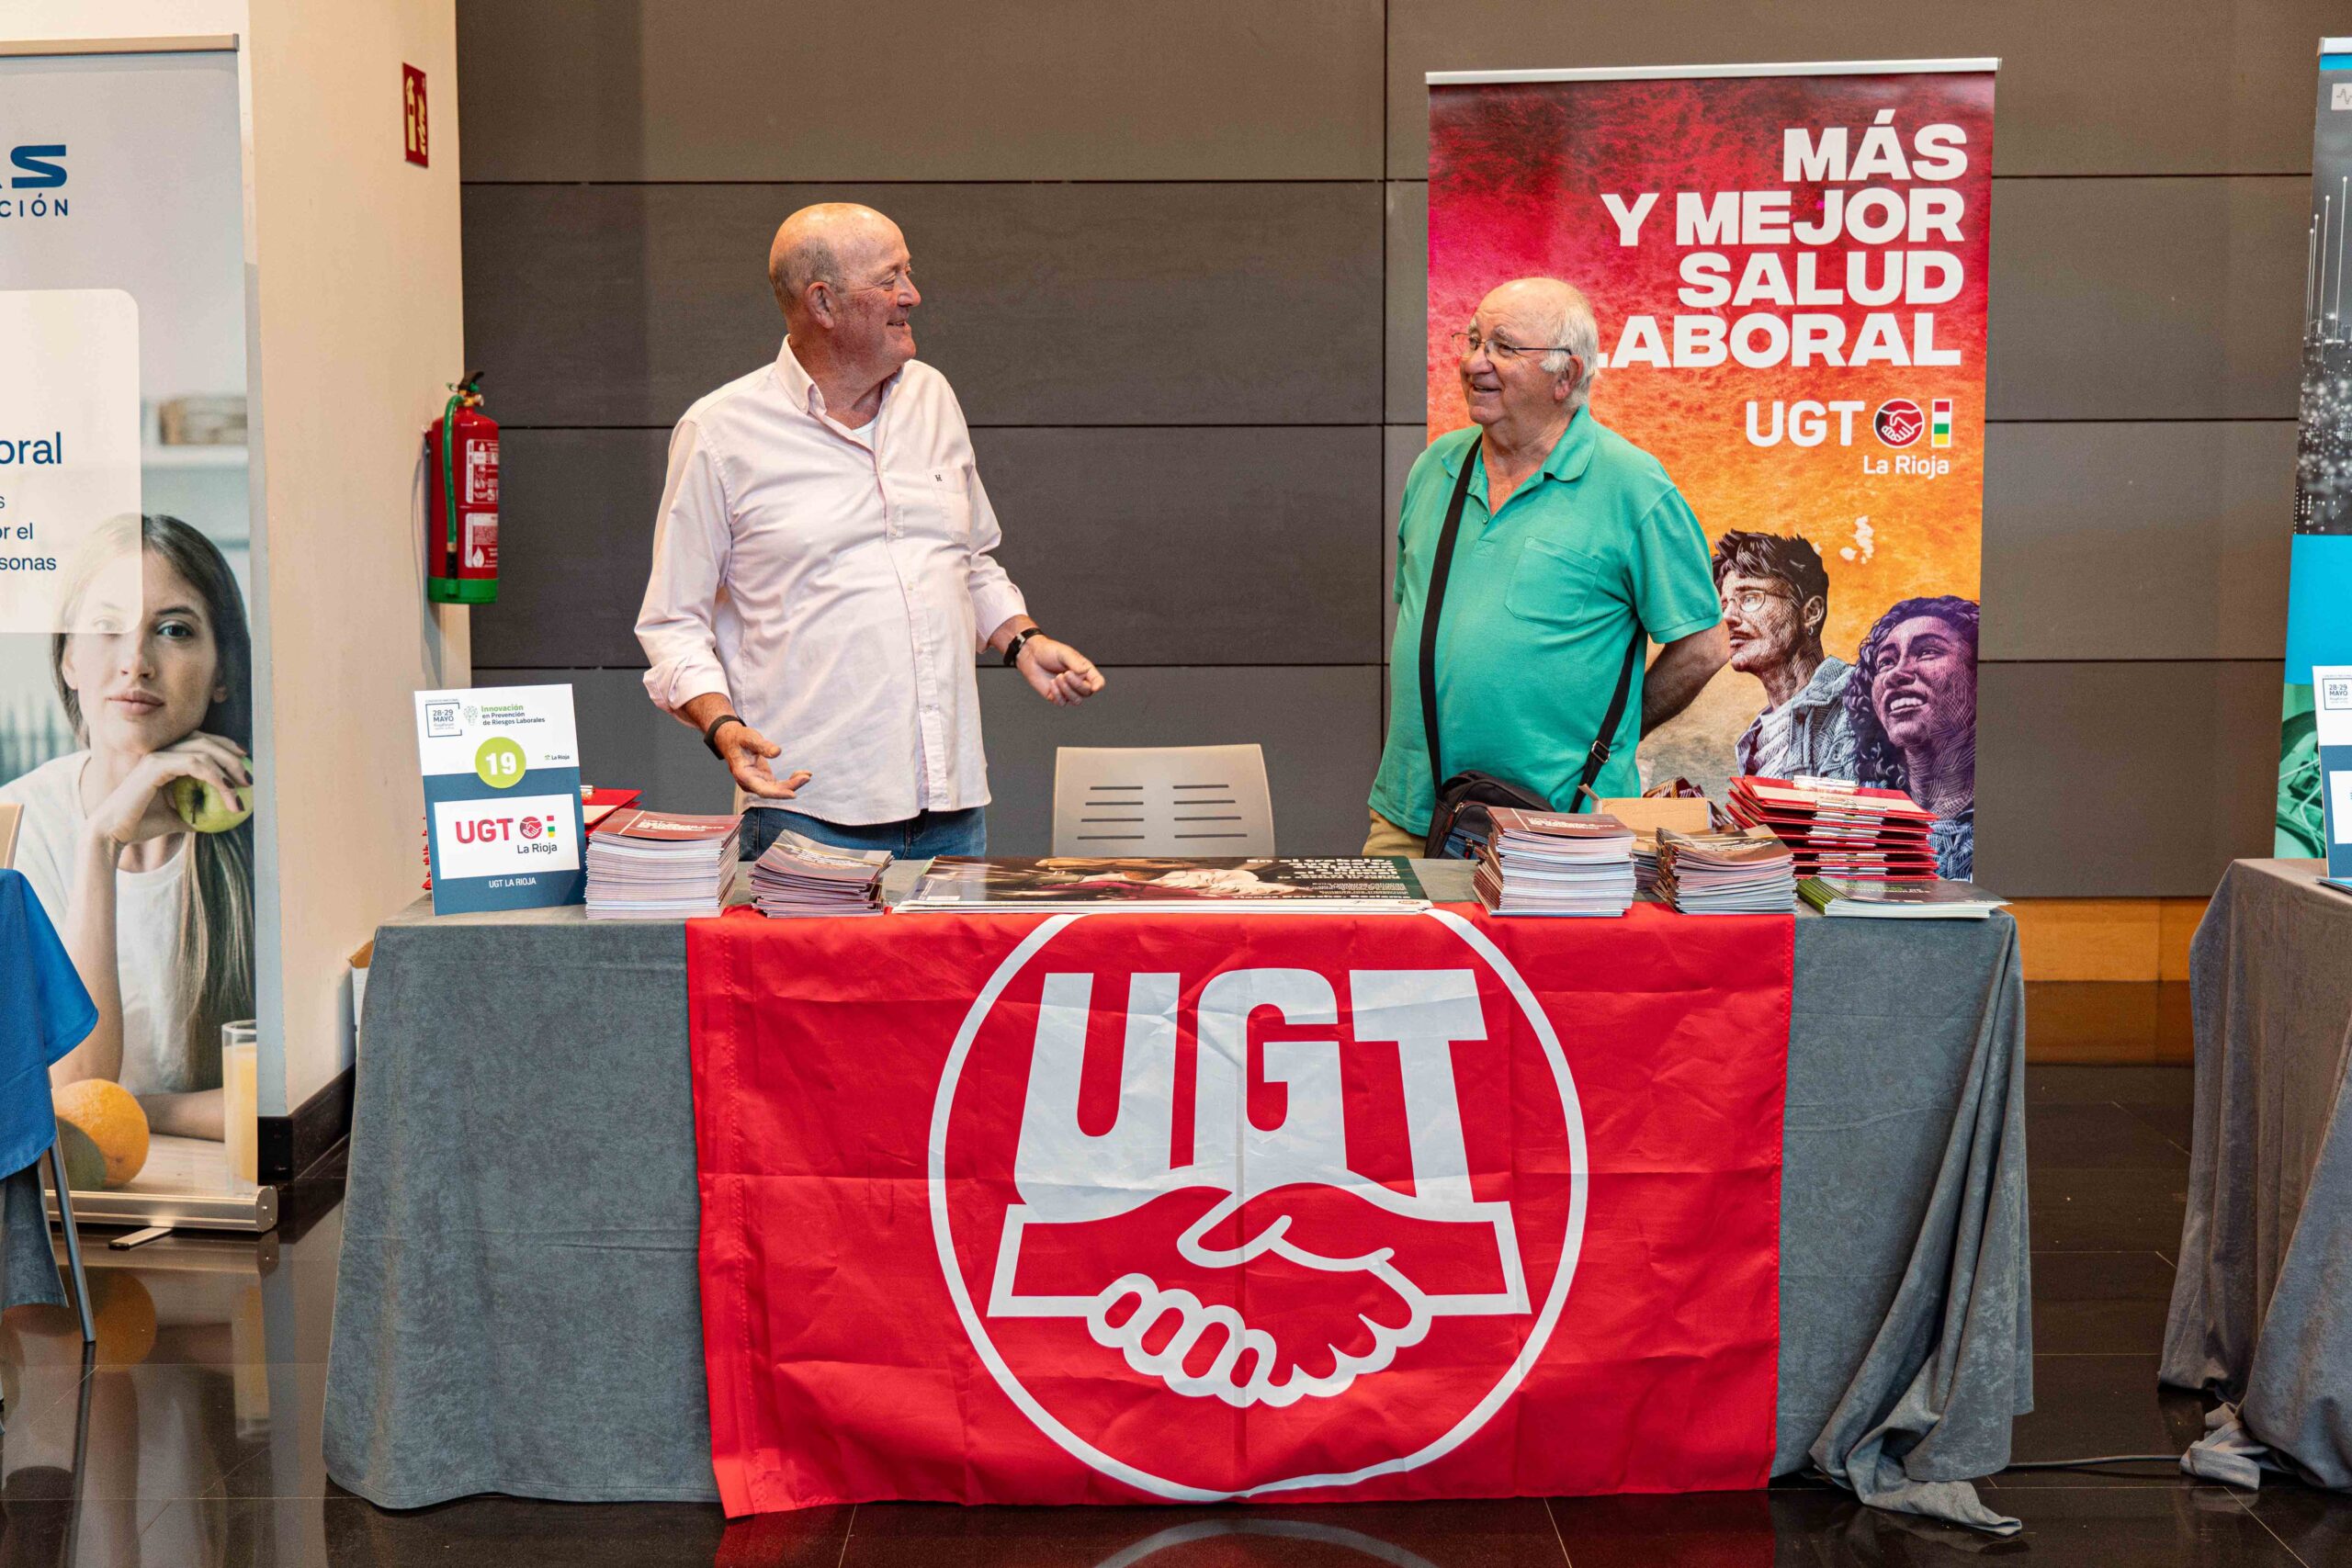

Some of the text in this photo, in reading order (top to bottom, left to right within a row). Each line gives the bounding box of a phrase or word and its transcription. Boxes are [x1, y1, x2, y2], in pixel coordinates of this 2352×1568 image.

[1783, 108, 1968, 182] MÁS
[0, 144, 68, 188] S
[0, 193, 68, 218] CIÓN
[1600, 187, 1965, 247] Y MEJOR
[1678, 249, 1964, 308] SALUD
[1597, 312, 1962, 368] ABORAL
[1745, 399, 1866, 448] UGT
[0, 431, 62, 465] oral
[1863, 455, 1950, 479] La Rioja
[0, 522, 33, 540] r el
[0, 557, 57, 570] sonas
[481, 704, 524, 713] Innovación
[492, 718, 515, 727] Riesgos
[485, 751, 517, 775] 19
[455, 818, 514, 844] UGT
[517, 842, 558, 854] La Rioja
[488, 877, 537, 888] UGT LA RIOJA
[1014, 966, 1489, 1211] UGT
